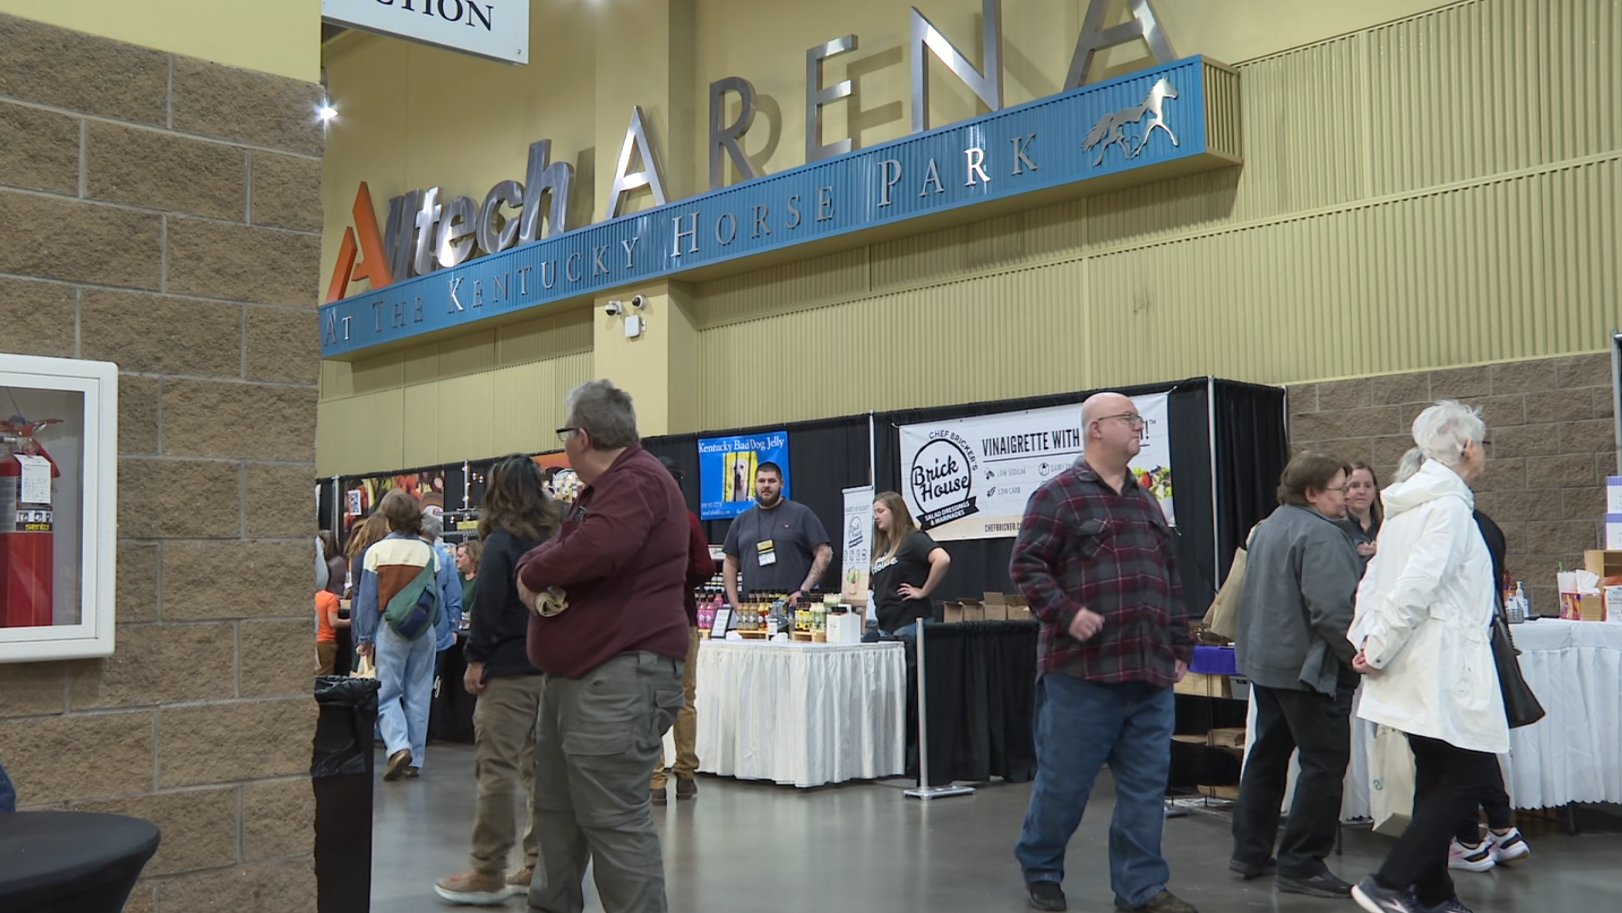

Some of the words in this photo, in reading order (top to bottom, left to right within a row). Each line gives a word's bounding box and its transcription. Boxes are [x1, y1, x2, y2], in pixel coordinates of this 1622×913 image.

[375, 0, 495, 32] ION
[325, 138, 574, 303] Alltech
[604, 0, 1178, 219] ARENA
[323, 311, 352, 347] AT
[372, 296, 425, 333] THE
[446, 236, 639, 315] KENTUCKY
[670, 186, 835, 257] HORSE
[877, 133, 1039, 207] PARK
[698, 440, 733, 454] Kentucky
[734, 439, 750, 450] Bad
[750, 438, 766, 451] Dog
[766, 435, 785, 450] Jelly
[928, 429, 950, 440] CHEF
[949, 432, 979, 471] BRICKER'S
[982, 432, 1049, 457] VINAIGRETTE
[1052, 428, 1080, 448] WITH
[912, 455, 959, 486] Brick
[997, 469, 1007, 477] LOW
[1008, 468, 1026, 477] SODIUM
[1051, 464, 1065, 473] DAIRY
[920, 475, 970, 502] House
[998, 487, 1008, 495] LOW
[1009, 486, 1020, 495] CARB
[925, 510, 941, 522] SALAD
[984, 522, 1021, 533] CHEFBRICKER.C
